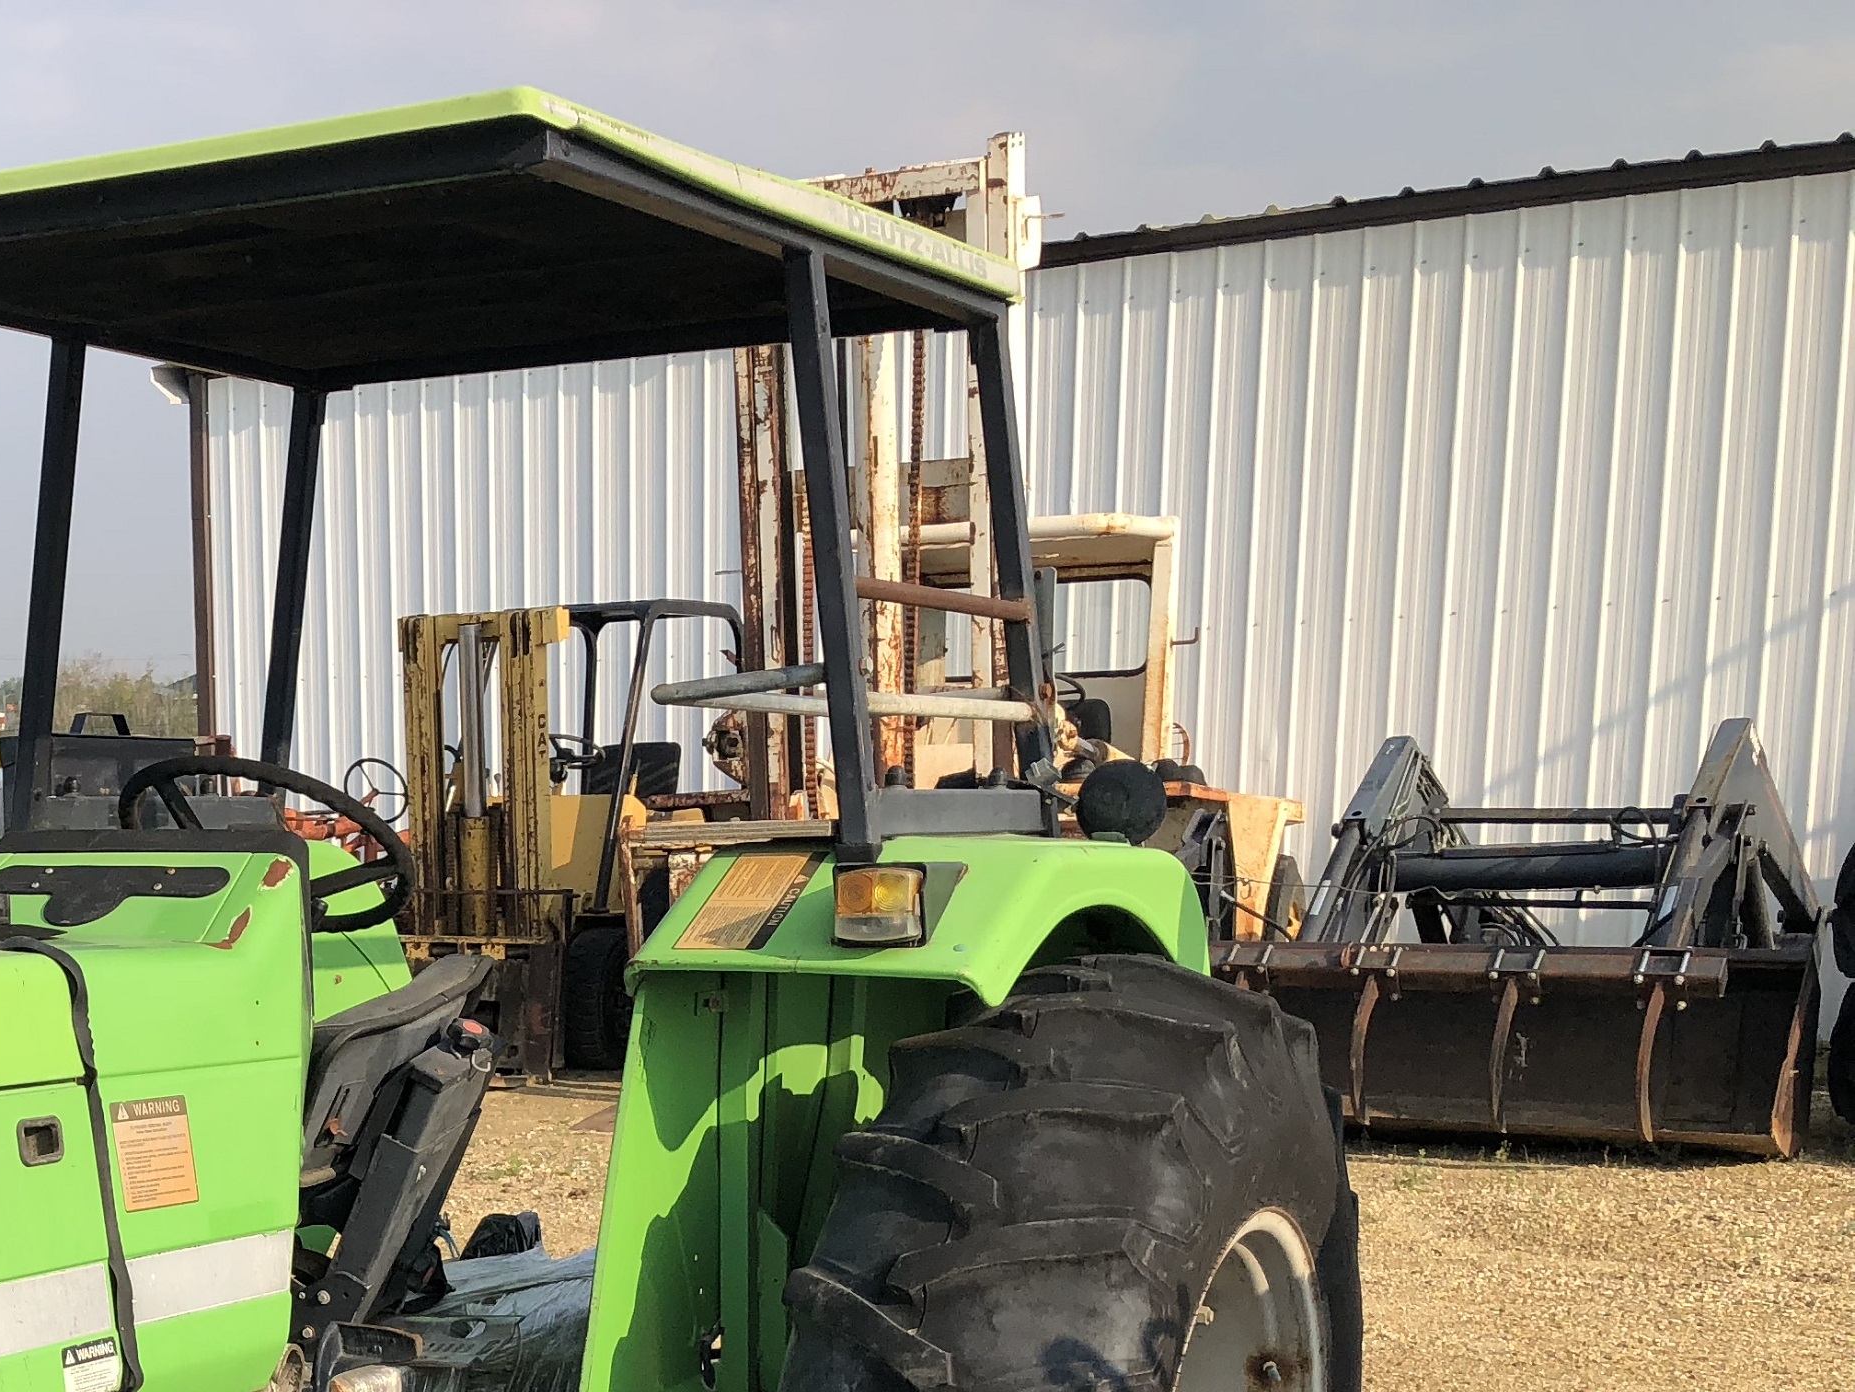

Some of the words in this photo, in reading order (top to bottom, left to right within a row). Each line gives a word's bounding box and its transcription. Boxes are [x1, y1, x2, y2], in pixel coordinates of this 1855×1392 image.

[847, 207, 989, 279] DEUTZ-ALLIS
[537, 713, 547, 759] CAT
[764, 885, 802, 927] CAUTION
[132, 1098, 181, 1117] WARNING
[76, 1340, 115, 1362] WARNING
